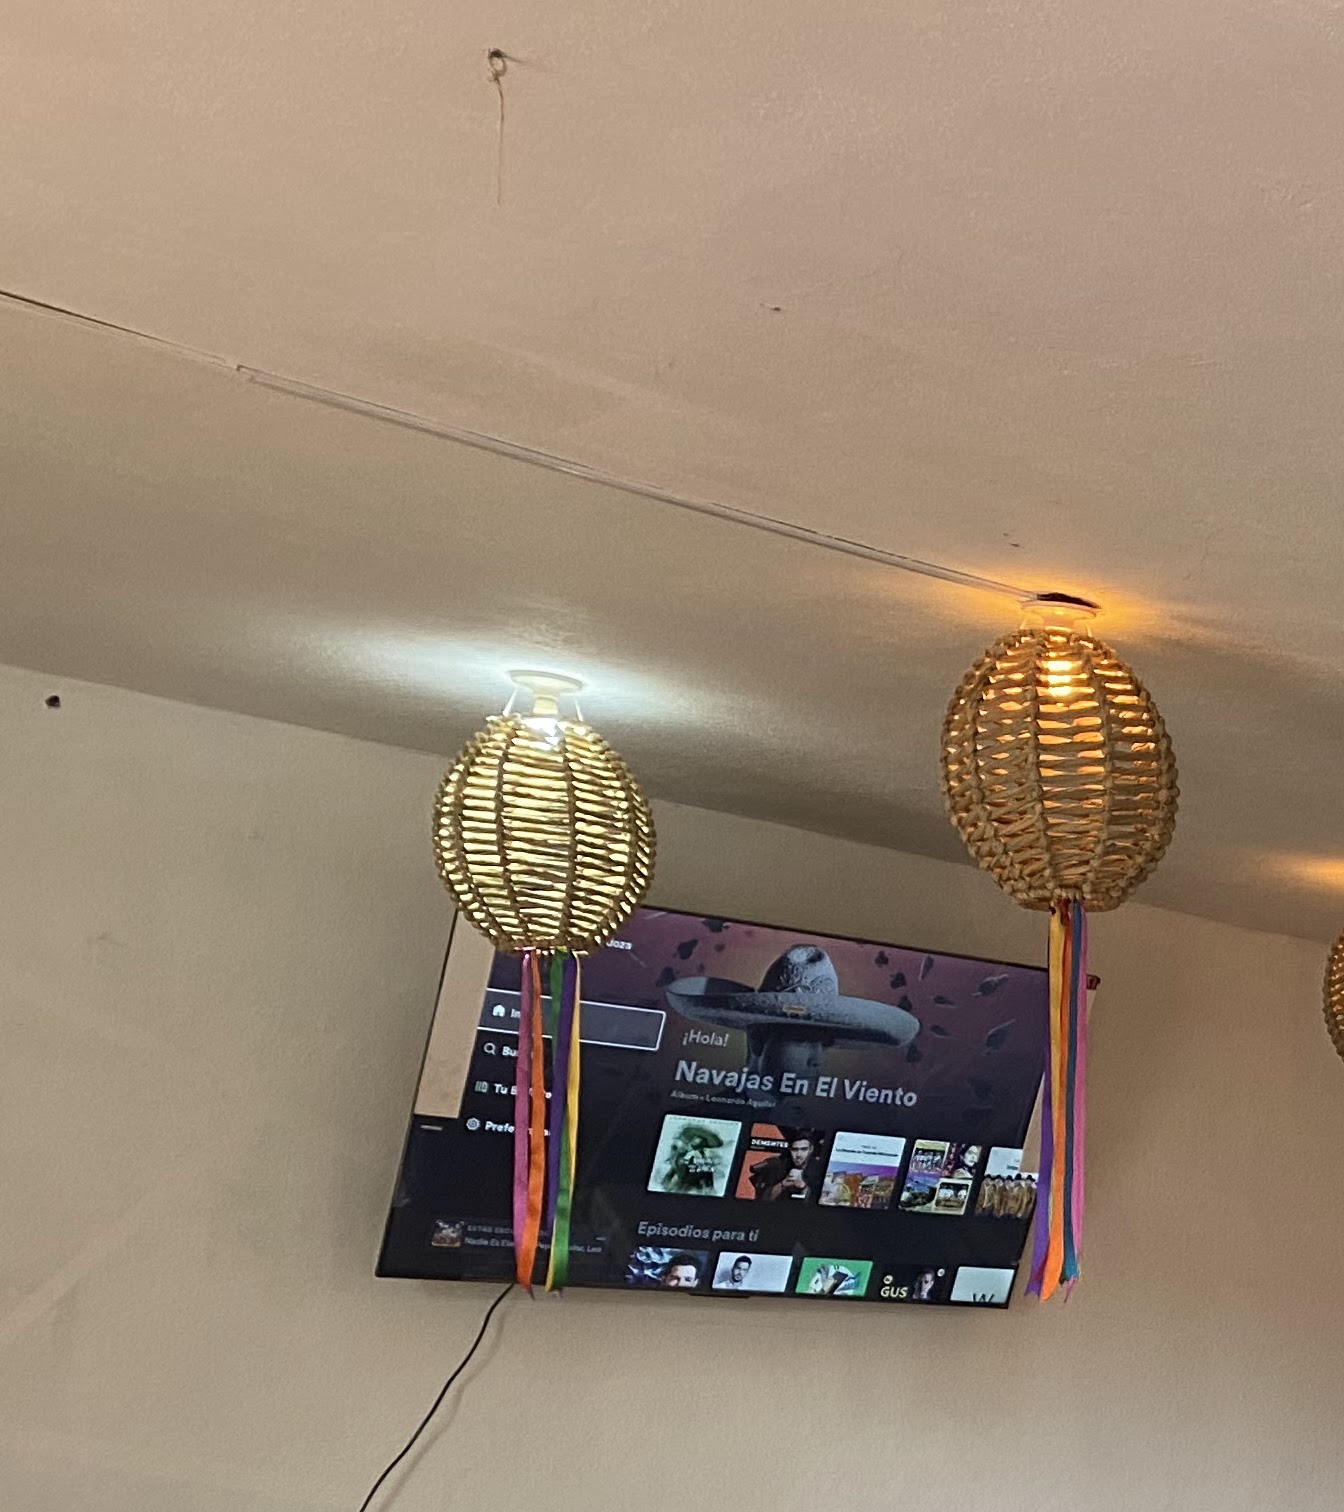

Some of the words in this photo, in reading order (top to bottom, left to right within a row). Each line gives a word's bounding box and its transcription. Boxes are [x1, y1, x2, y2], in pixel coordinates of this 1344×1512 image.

[682, 1030, 729, 1047] ¡Hola!
[674, 1060, 774, 1093] Navajas
[780, 1072, 808, 1096] En
[815, 1076, 838, 1098] El
[844, 1078, 917, 1107] Viento
[637, 1221, 709, 1239] Episodios
[712, 1230, 745, 1242] para
[749, 1229, 759, 1242] ti
[880, 1286, 908, 1298] GUS
